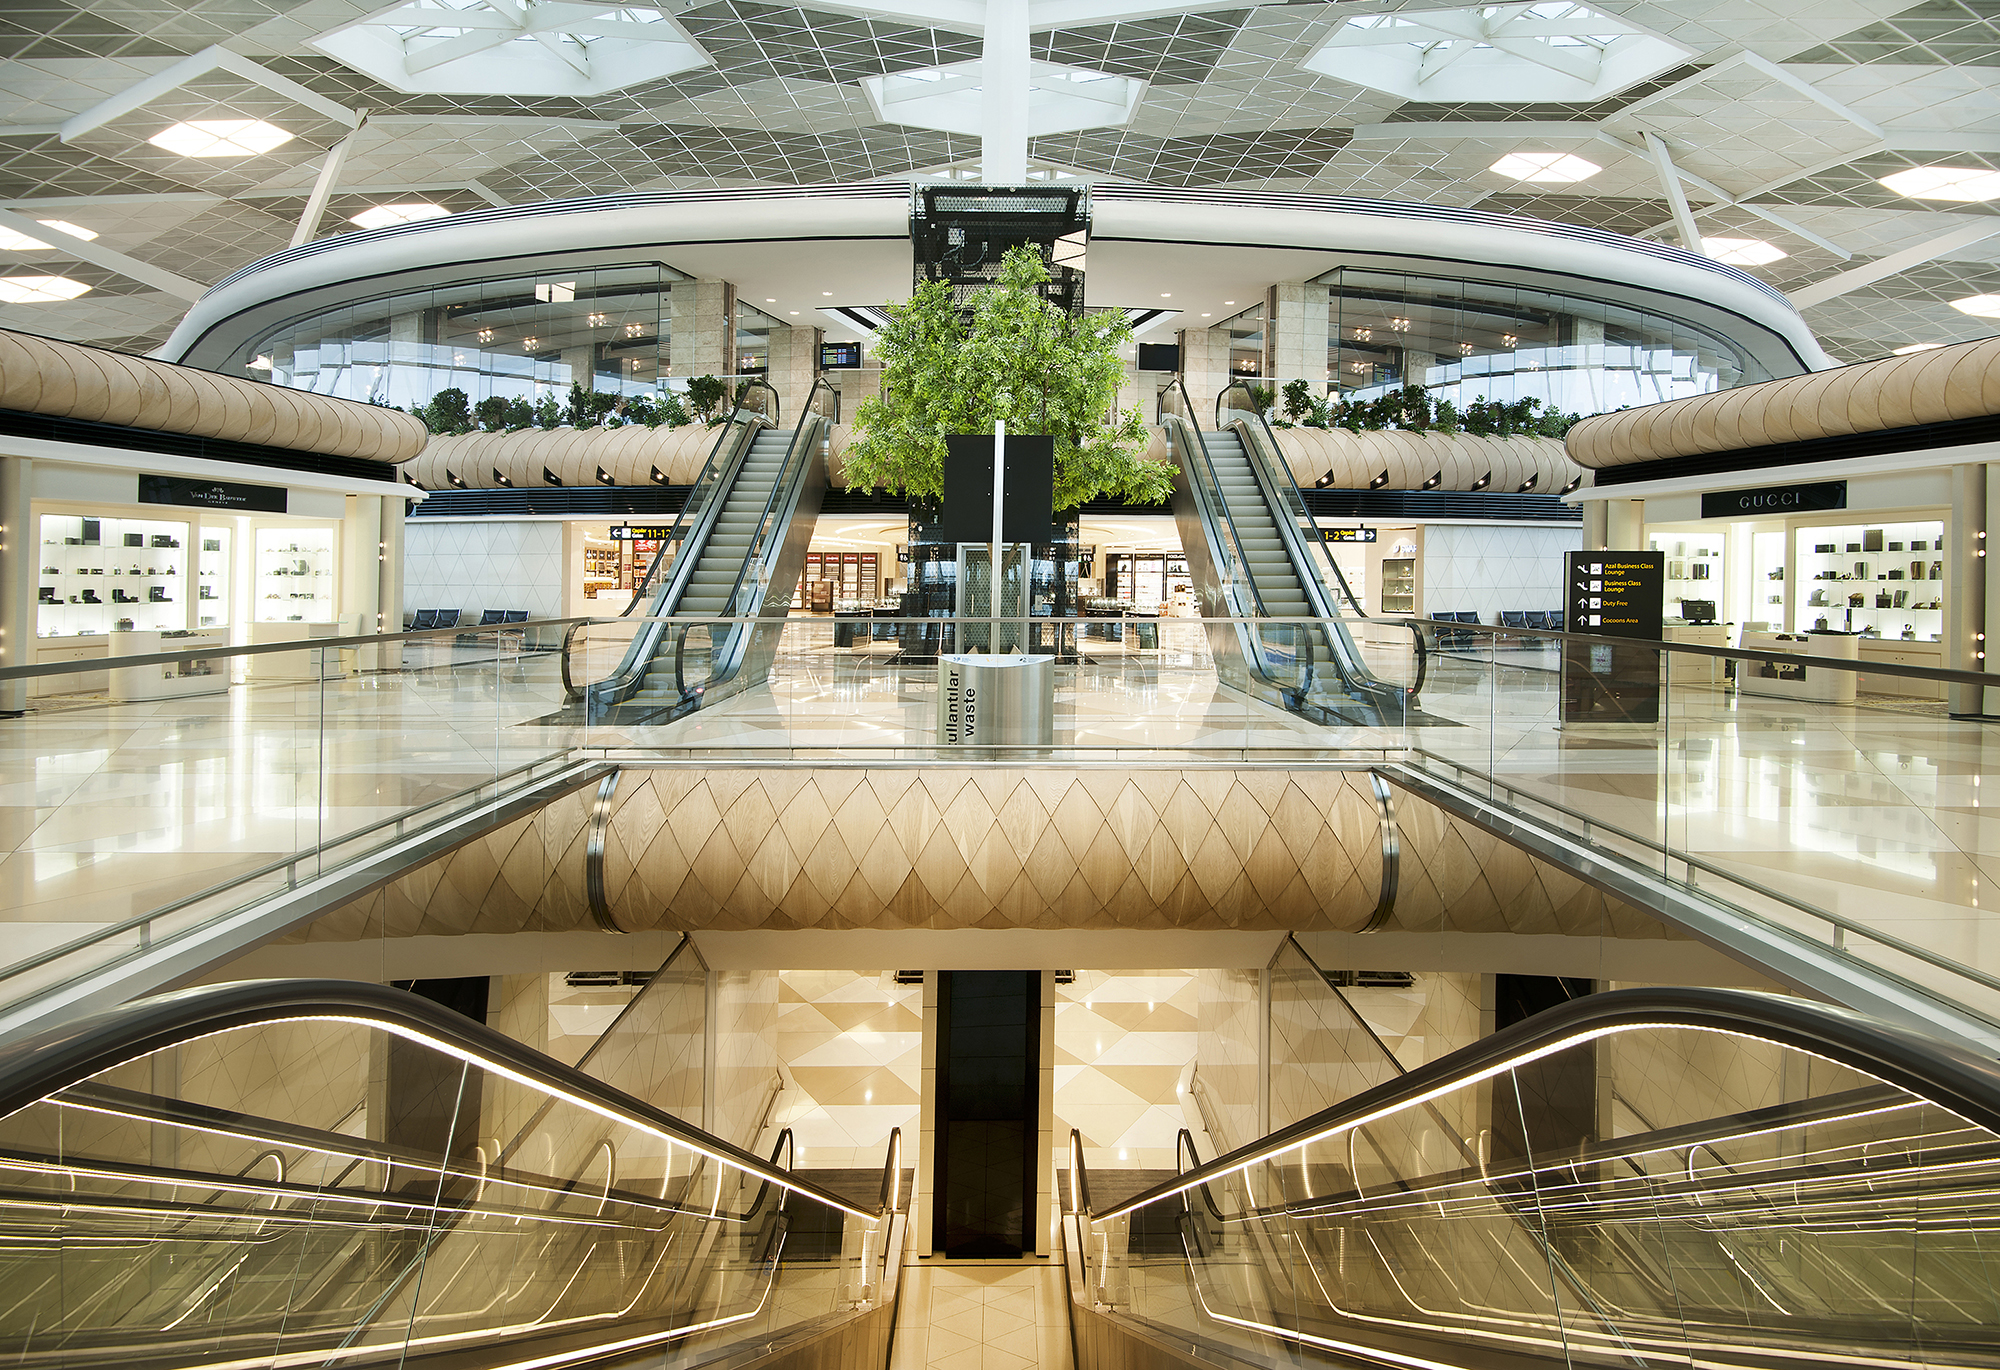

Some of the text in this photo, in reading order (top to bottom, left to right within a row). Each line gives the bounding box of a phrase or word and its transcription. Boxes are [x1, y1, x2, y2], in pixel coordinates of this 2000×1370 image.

[1740, 492, 1799, 508] GUCCI
[1324, 530, 1340, 540] 1-2
[946, 670, 959, 745] ullantılar
[963, 688, 976, 736] waste
